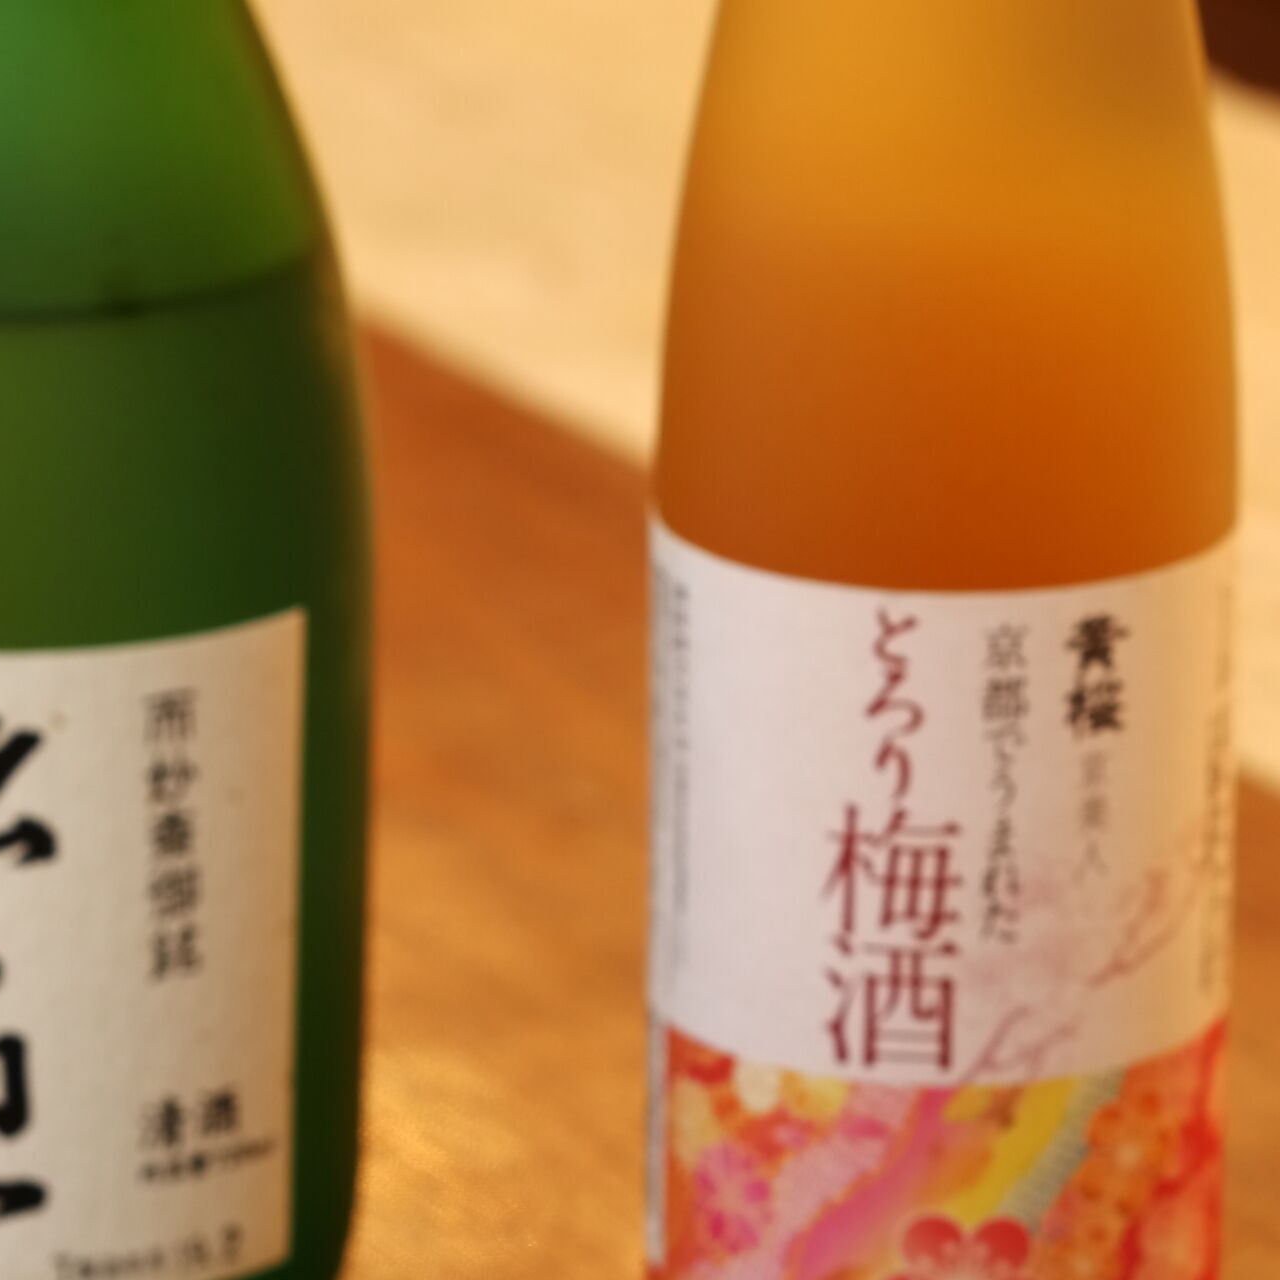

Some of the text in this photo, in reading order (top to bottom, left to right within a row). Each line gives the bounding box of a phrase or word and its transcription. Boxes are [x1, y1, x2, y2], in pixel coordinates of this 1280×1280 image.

[822, 605, 962, 1070] とろり梅酒
